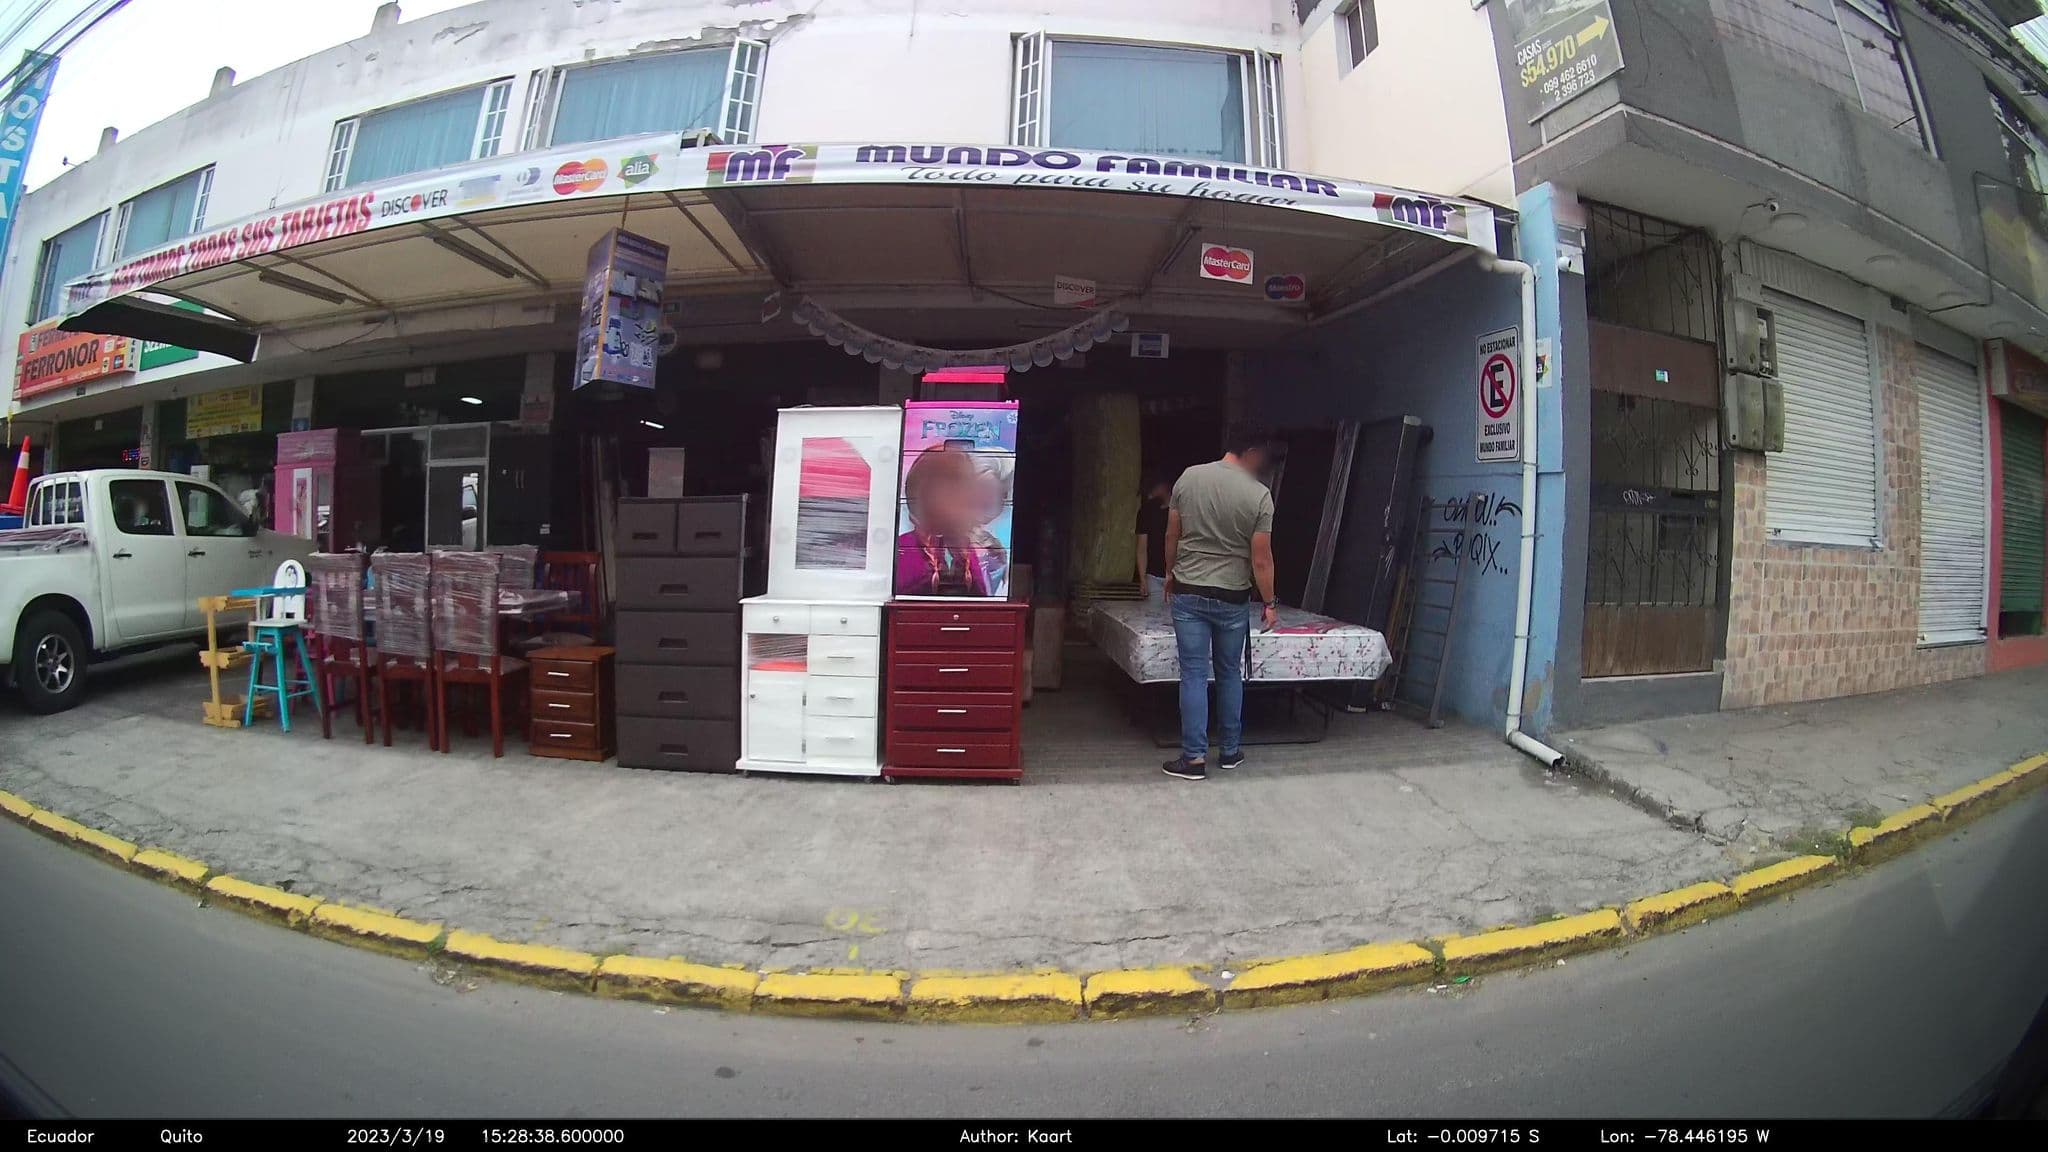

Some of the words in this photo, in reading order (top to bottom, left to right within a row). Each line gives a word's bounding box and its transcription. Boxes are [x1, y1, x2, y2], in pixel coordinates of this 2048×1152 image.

[1517, 39, 1542, 66] CASAS
[1520, 35, 1576, 88] $54.970
[1543, 76, 1560, 94] 099
[1560, 67, 1576, 84] 462
[1554, 90, 1560, 102] 2
[1578, 69, 1596, 88] 723
[624, 160, 650, 177] alia
[856, 145, 1082, 170] MUNDO
[1096, 155, 1340, 198] FAMILIAR
[900, 166, 998, 182] Todo
[1013, 173, 1114, 188] para
[1127, 179, 1172, 193] su
[380, 188, 449, 218] DISCOVER
[1202, 255, 1251, 272] MasterCard
[1056, 280, 1096, 295] DISCOVER
[1479, 343, 1487, 356] NO
[1487, 336, 1516, 354] ESTACIONAR
[24, 338, 101, 383] FERRONOR
[920, 420, 1001, 441] FROZEN
[1484, 422, 1511, 437] EXCLUSIVO
[1479, 442, 1495, 454] MUNDO
[1495, 439, 1516, 452] FAMILIAR
